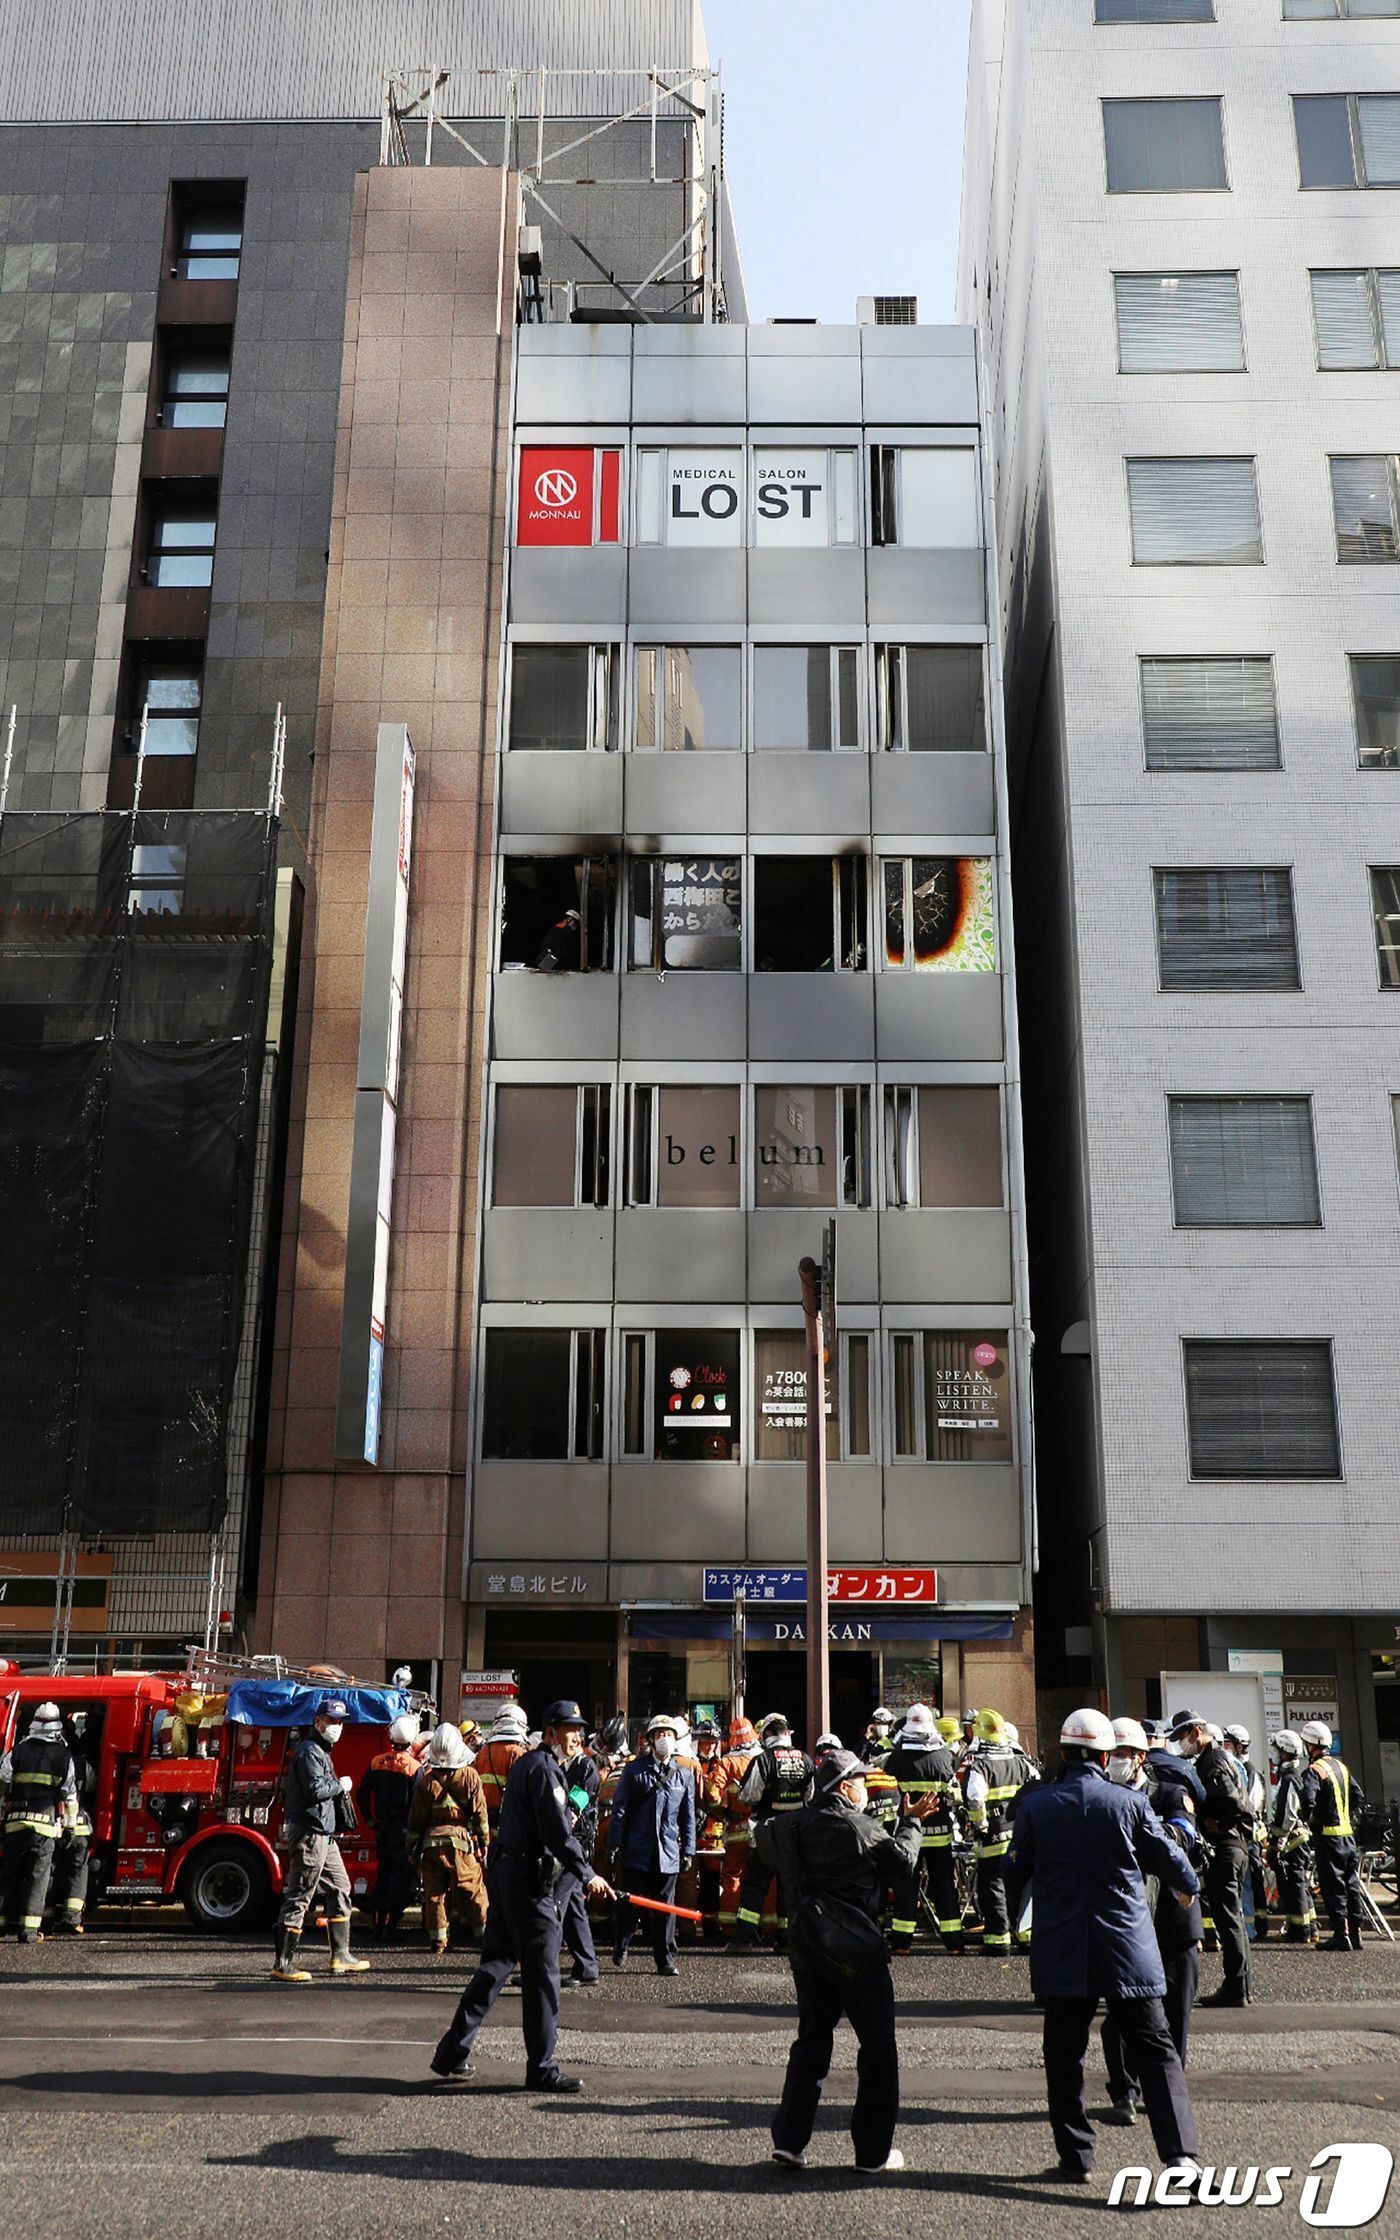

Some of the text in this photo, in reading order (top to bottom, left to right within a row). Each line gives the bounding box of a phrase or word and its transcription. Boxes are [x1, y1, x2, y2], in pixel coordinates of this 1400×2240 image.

[673, 470, 806, 479] MEDICAL SALON
[665, 1135, 826, 1165] belum
[765, 1416, 807, 1428] 入会者募
[488, 1574, 588, 1593] 堂島北ビル
[708, 1573, 804, 1585] カスタムオーダー
[774, 1624, 872, 1640] DAKAN
[480, 1674, 501, 1682] LOST
[1290, 1711, 1335, 1721] FULLCAST
